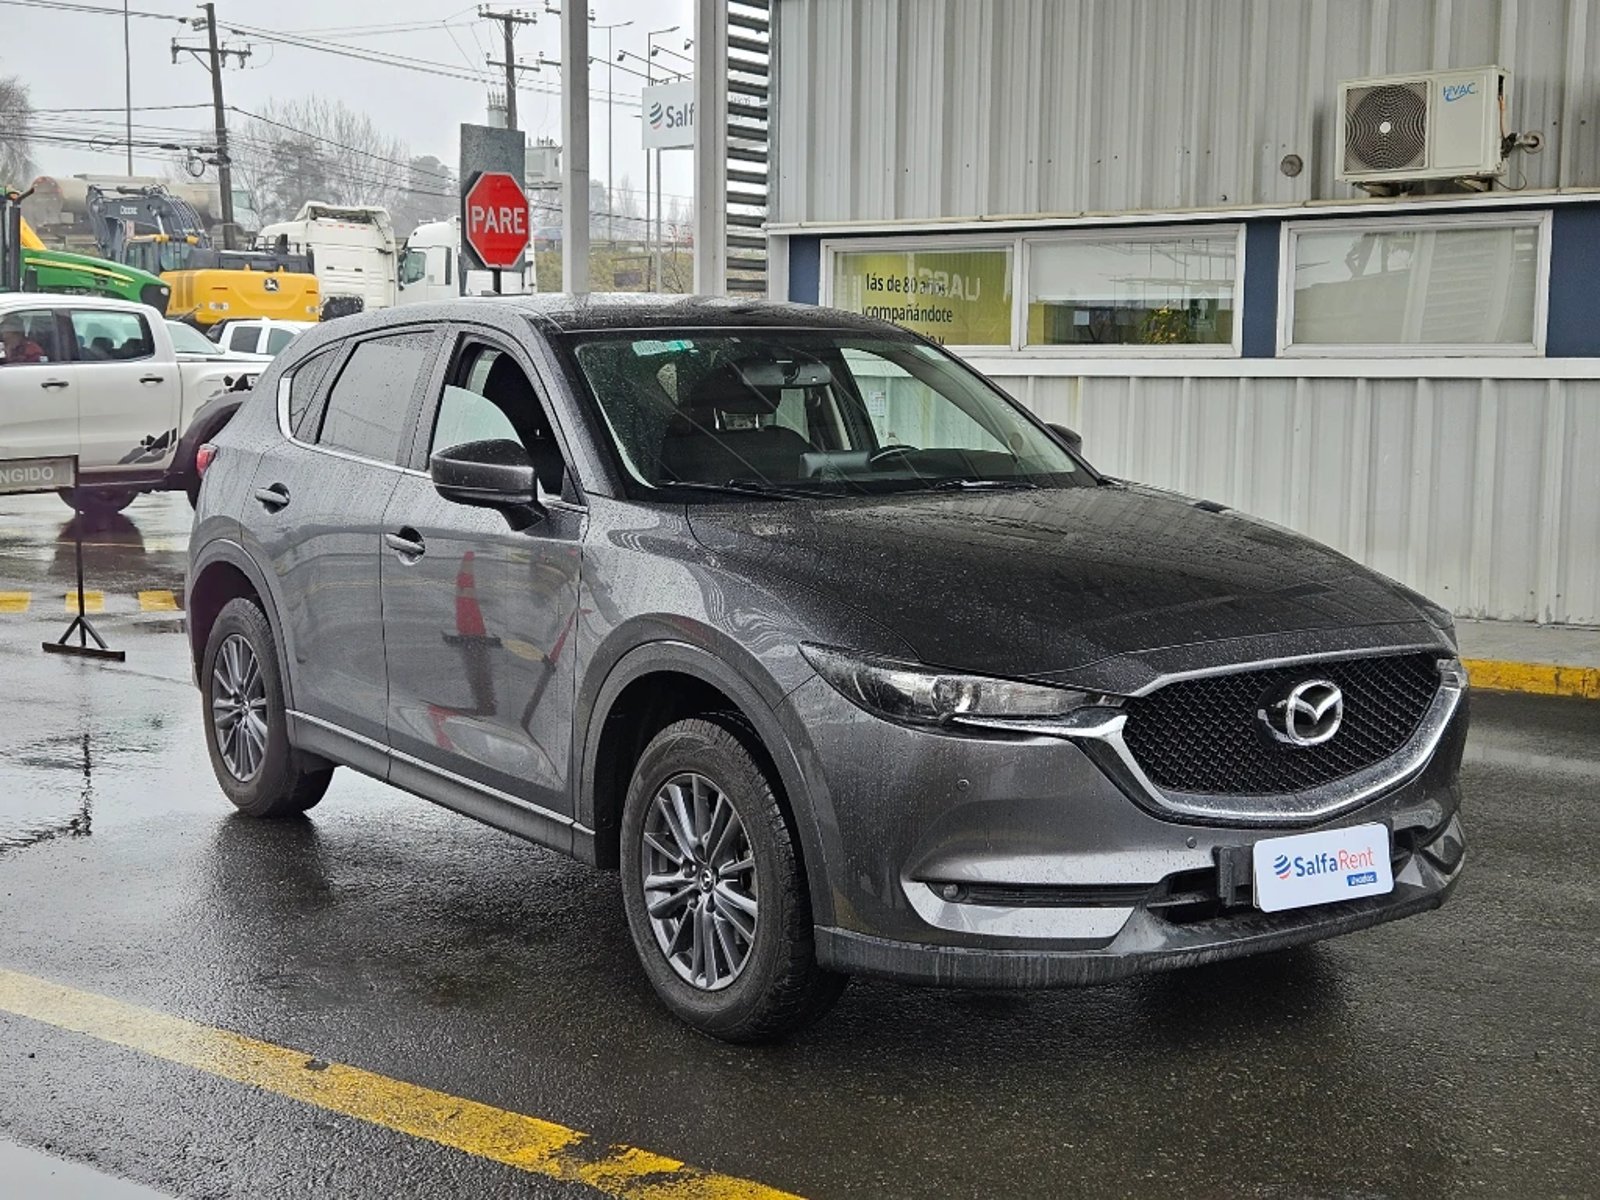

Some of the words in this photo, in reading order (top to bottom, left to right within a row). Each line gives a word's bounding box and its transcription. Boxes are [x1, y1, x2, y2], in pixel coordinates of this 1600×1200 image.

[471, 205, 525, 234] PARE
[887, 274, 901, 293] de
[903, 276, 917, 294] 80
[1294, 847, 1374, 876] SalfaRent
